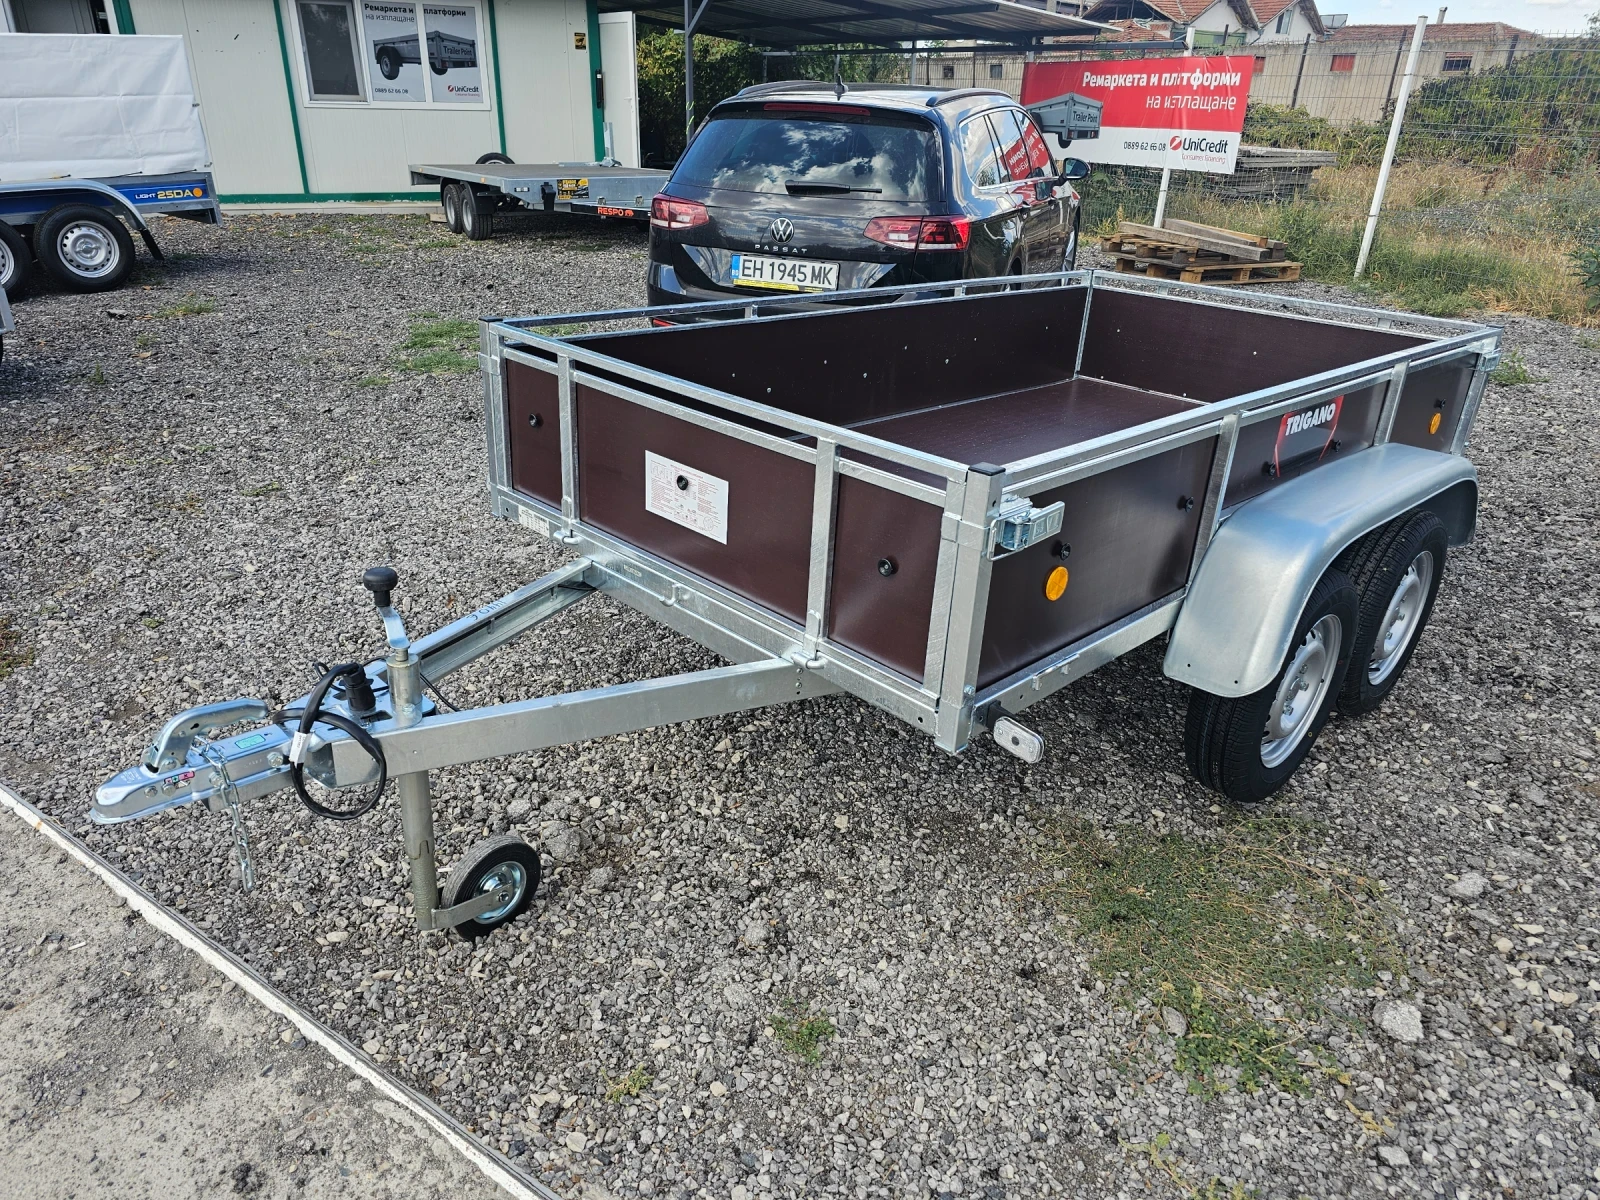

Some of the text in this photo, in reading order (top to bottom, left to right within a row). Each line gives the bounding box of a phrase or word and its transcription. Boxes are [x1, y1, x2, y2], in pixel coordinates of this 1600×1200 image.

[364, 3, 407, 14] Ремаркета
[424, 8, 466, 17] платформи
[376, 14, 415, 23] изплащане
[443, 46, 472, 56] Trailer Point
[1082, 68, 1241, 90] Ремаркета и плтформи
[454, 85, 479, 93] UniCredit
[1146, 95, 1160, 109] на
[1123, 141, 1139, 150] 0889
[1140, 141, 1148, 150] 62
[1158, 142, 1167, 152] 08
[1182, 137, 1229, 154] UniCredit
[157, 189, 193, 199] 25DA
[597, 206, 624, 216] RESPO
[755, 244, 808, 254] PASSAT
[742, 258, 764, 279] EH
[769, 261, 807, 283] 1945
[810, 265, 834, 286] MK
[1285, 402, 1337, 436] TRIGANO
